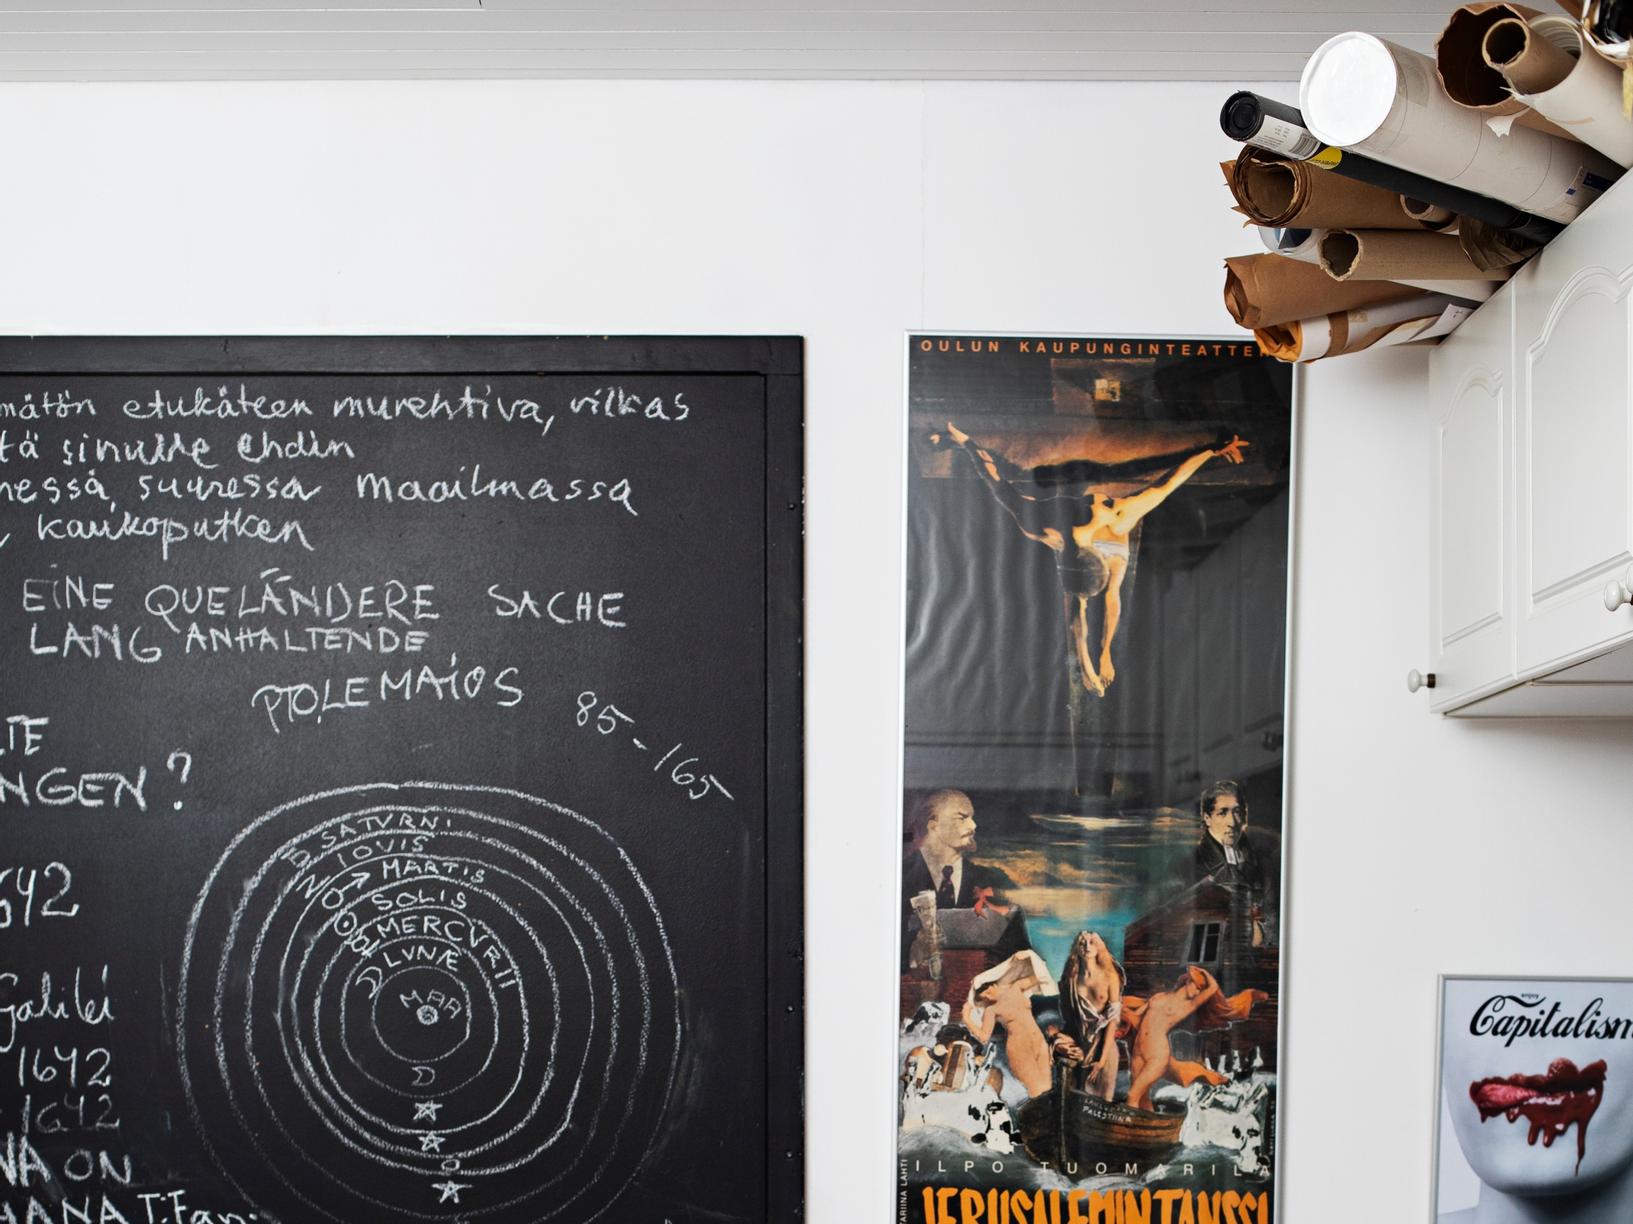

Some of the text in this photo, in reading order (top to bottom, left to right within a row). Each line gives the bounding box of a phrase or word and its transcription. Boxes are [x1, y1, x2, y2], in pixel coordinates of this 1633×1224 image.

[921, 340, 1264, 357] OULUN KAUPUNGINTEATTE
[570, 386, 690, 421] vilkas
[23, 566, 115, 612] EINE
[488, 583, 626, 627] SACHE
[30, 622, 430, 663] LANG ANHALTENDE
[0, 715, 49, 756] TE
[337, 836, 428, 868] IOVIS
[382, 859, 485, 883] MARTIS
[371, 889, 467, 910] SOLIS
[1470, 995, 1633, 1047] Capitalism
[19, 1047, 111, 1087] 1642
[900, 1159, 908, 1186] LAHTI
[915, 1160, 1004, 1174] ILPO
